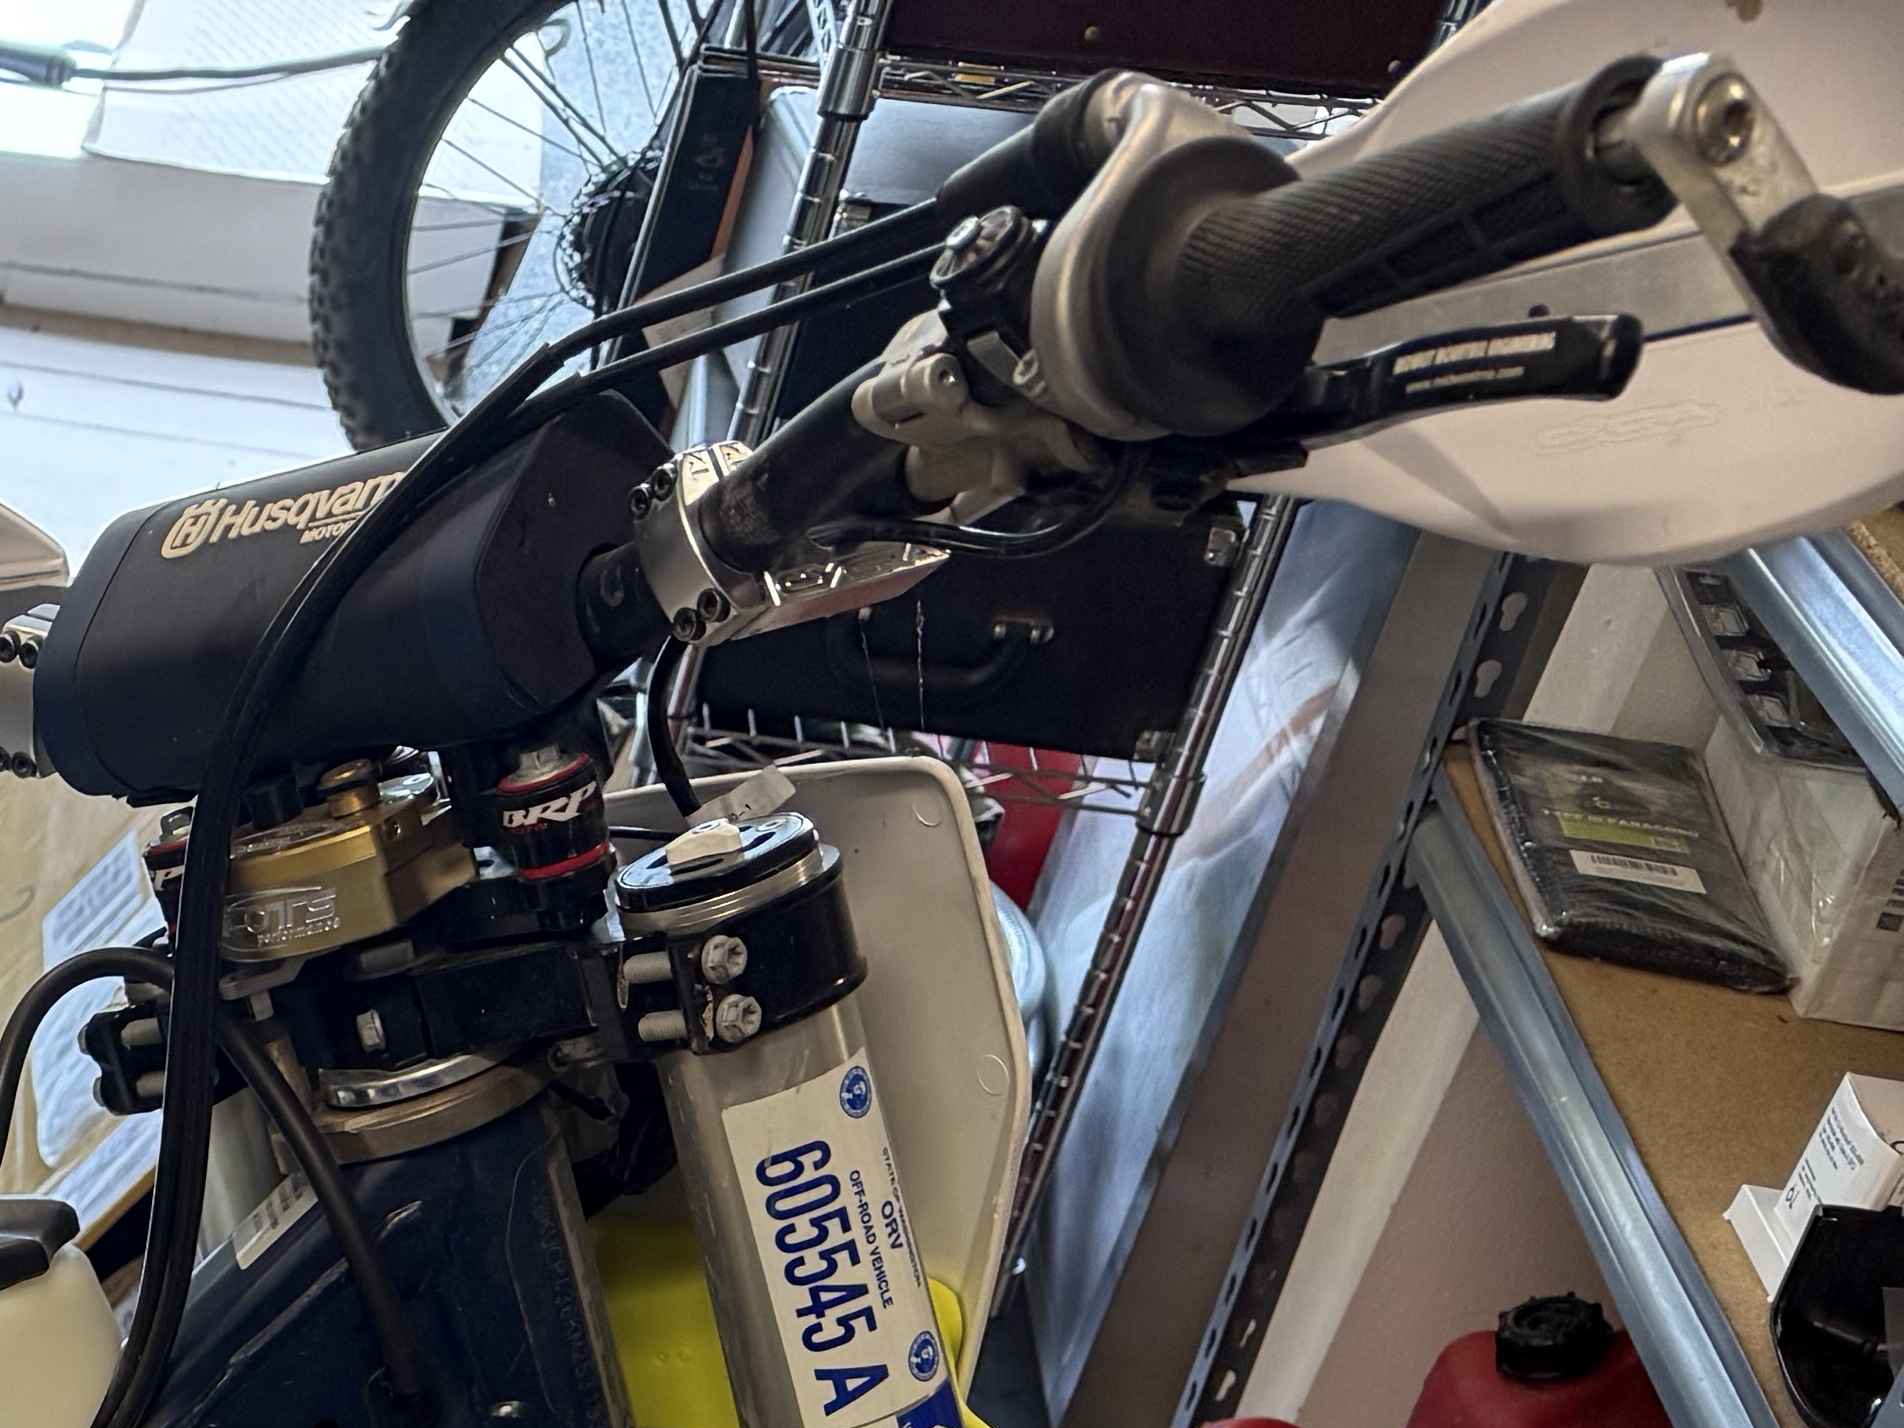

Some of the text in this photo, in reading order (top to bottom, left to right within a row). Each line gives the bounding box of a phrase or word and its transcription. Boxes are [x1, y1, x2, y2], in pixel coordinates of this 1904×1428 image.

[501, 781, 598, 832] BRP
[849, 1170, 894, 1309] OFF-ROAD VEHICLE
[880, 1200, 905, 1251] ORV
[755, 1139, 880, 1417] 605545 A
